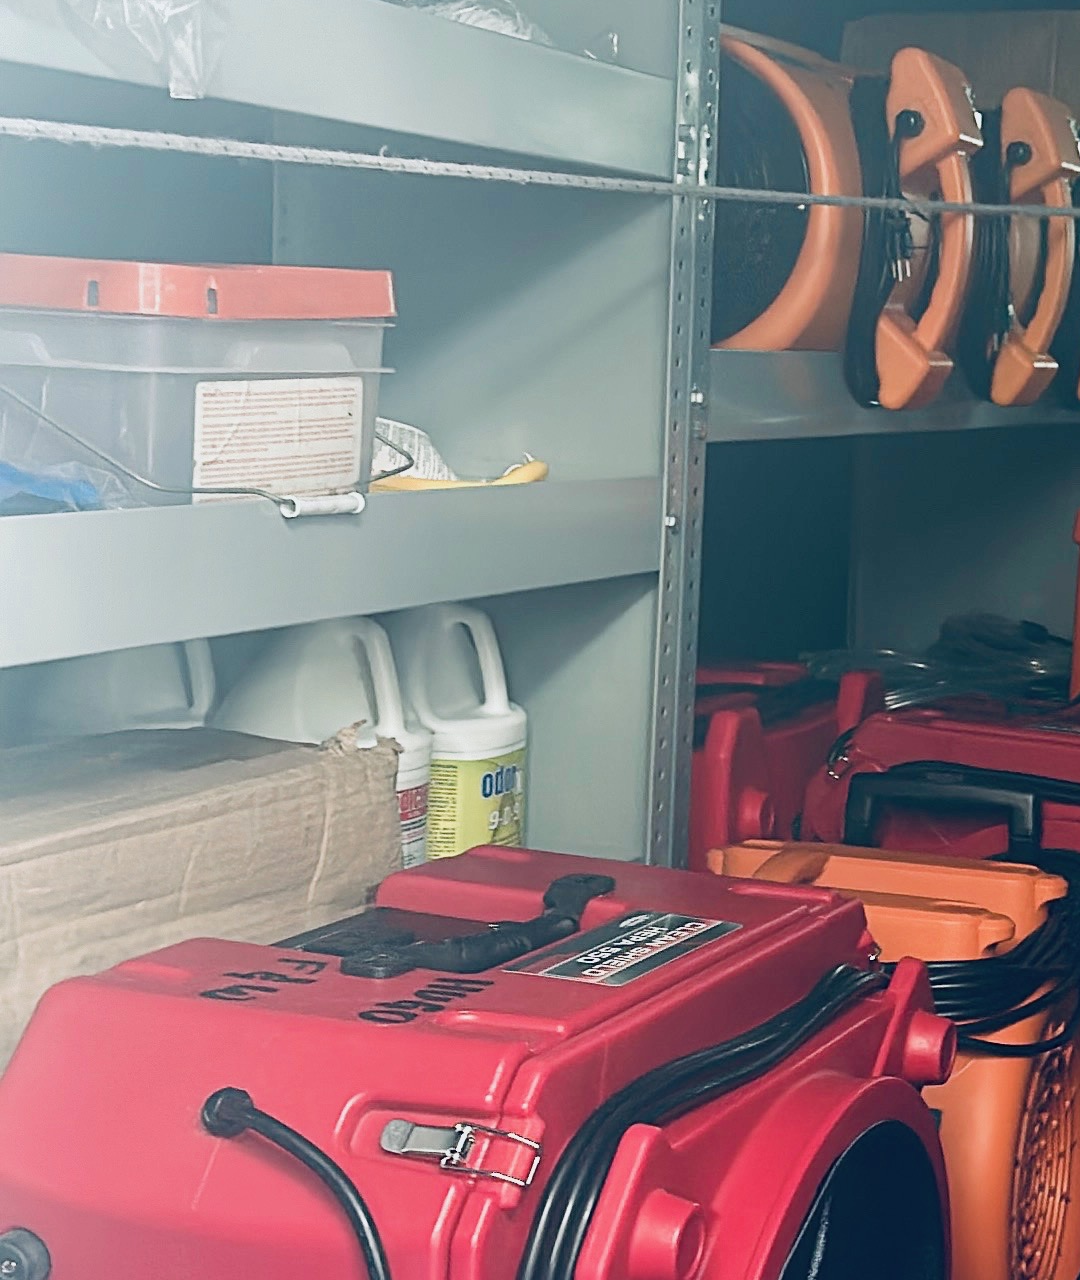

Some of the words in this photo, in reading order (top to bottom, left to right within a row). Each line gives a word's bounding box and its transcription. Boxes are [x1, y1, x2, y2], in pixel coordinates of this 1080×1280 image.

[613, 926, 669, 947] HEPA
[651, 921, 708, 950] CLEAN
[576, 946, 623, 965] 550
[581, 946, 652, 977] SHIELD
[358, 977, 494, 1024] HUGO
